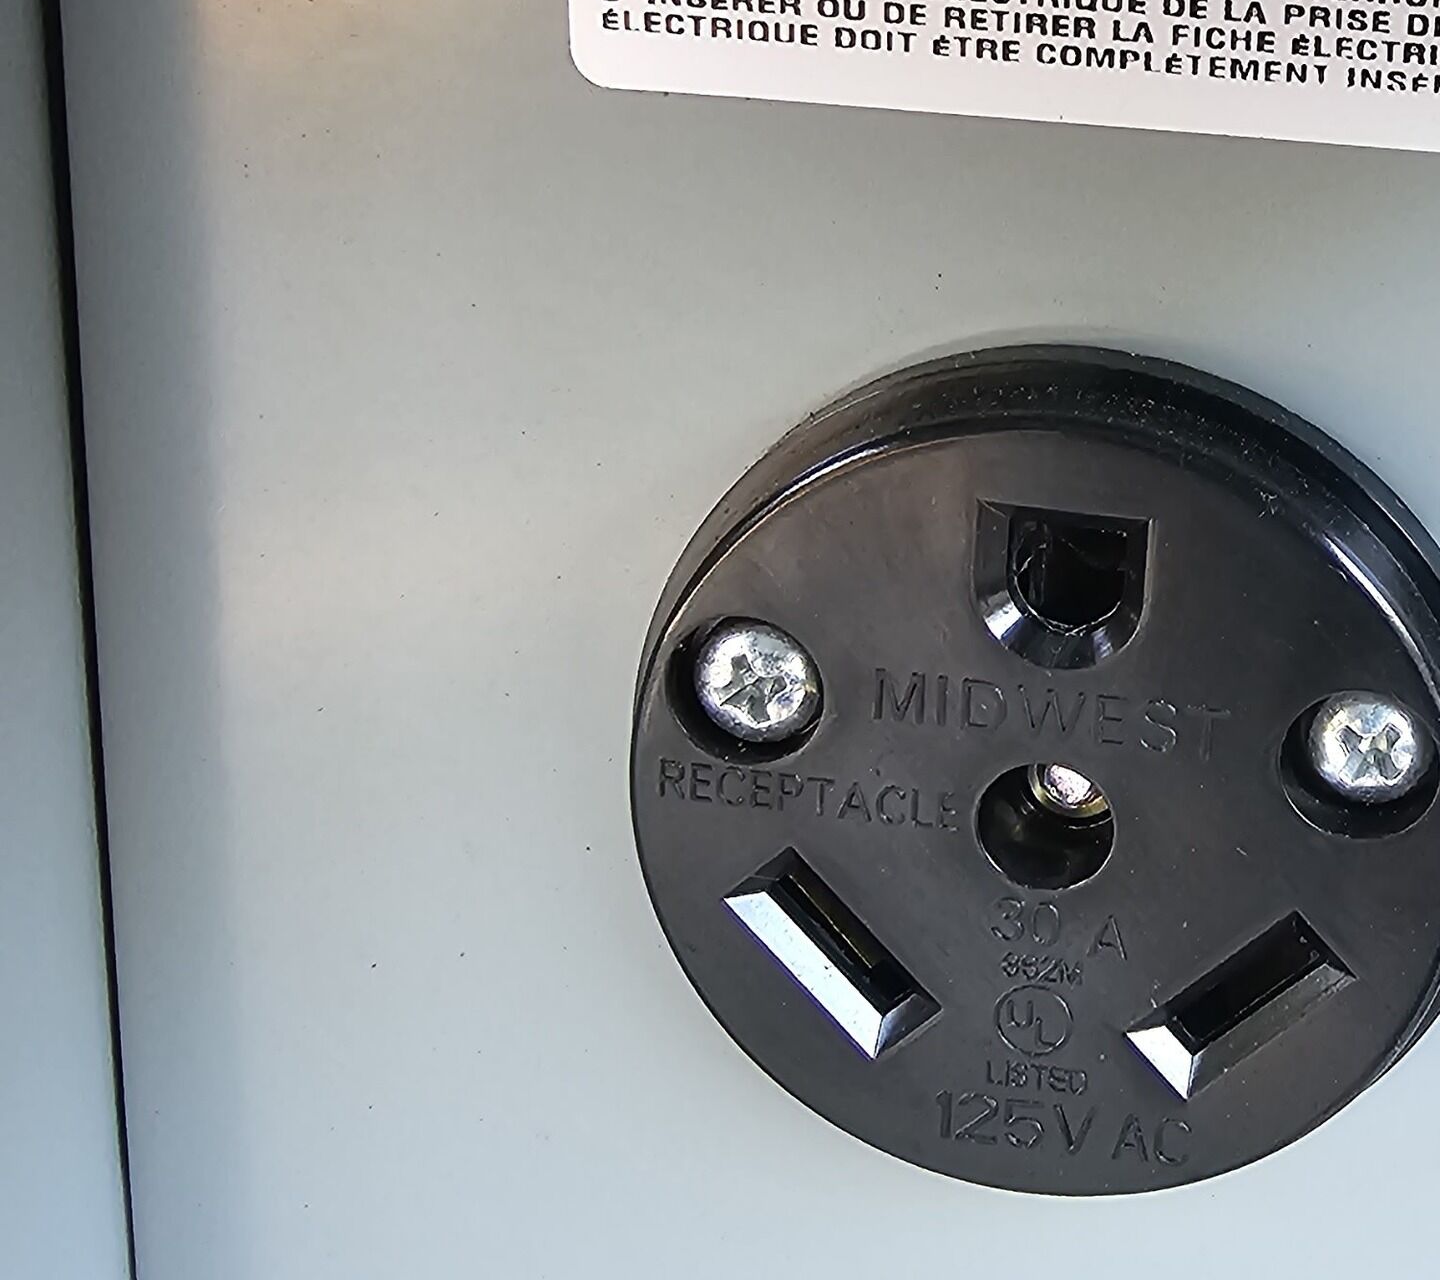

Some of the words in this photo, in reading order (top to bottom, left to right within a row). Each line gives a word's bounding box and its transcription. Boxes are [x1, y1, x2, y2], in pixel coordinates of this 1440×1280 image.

[601, 6, 820, 48] ÉLECTRIQUE
[833, 25, 919, 54] DOIT
[882, 0, 928, 27] DE
[943, 5, 1097, 41] RETIRER
[1111, 18, 1155, 45] LA
[1170, 22, 1277, 55] FICHE
[1283, 2, 1392, 36] PRISE
[872, 667, 1231, 762] MIDWEST
[655, 756, 959, 833] RECEPTACLE
[989, 895, 1063, 948] 30
[1086, 911, 1130, 963] A
[985, 1058, 1089, 1097] LISTED
[1110, 1111, 1195, 1168] AC
